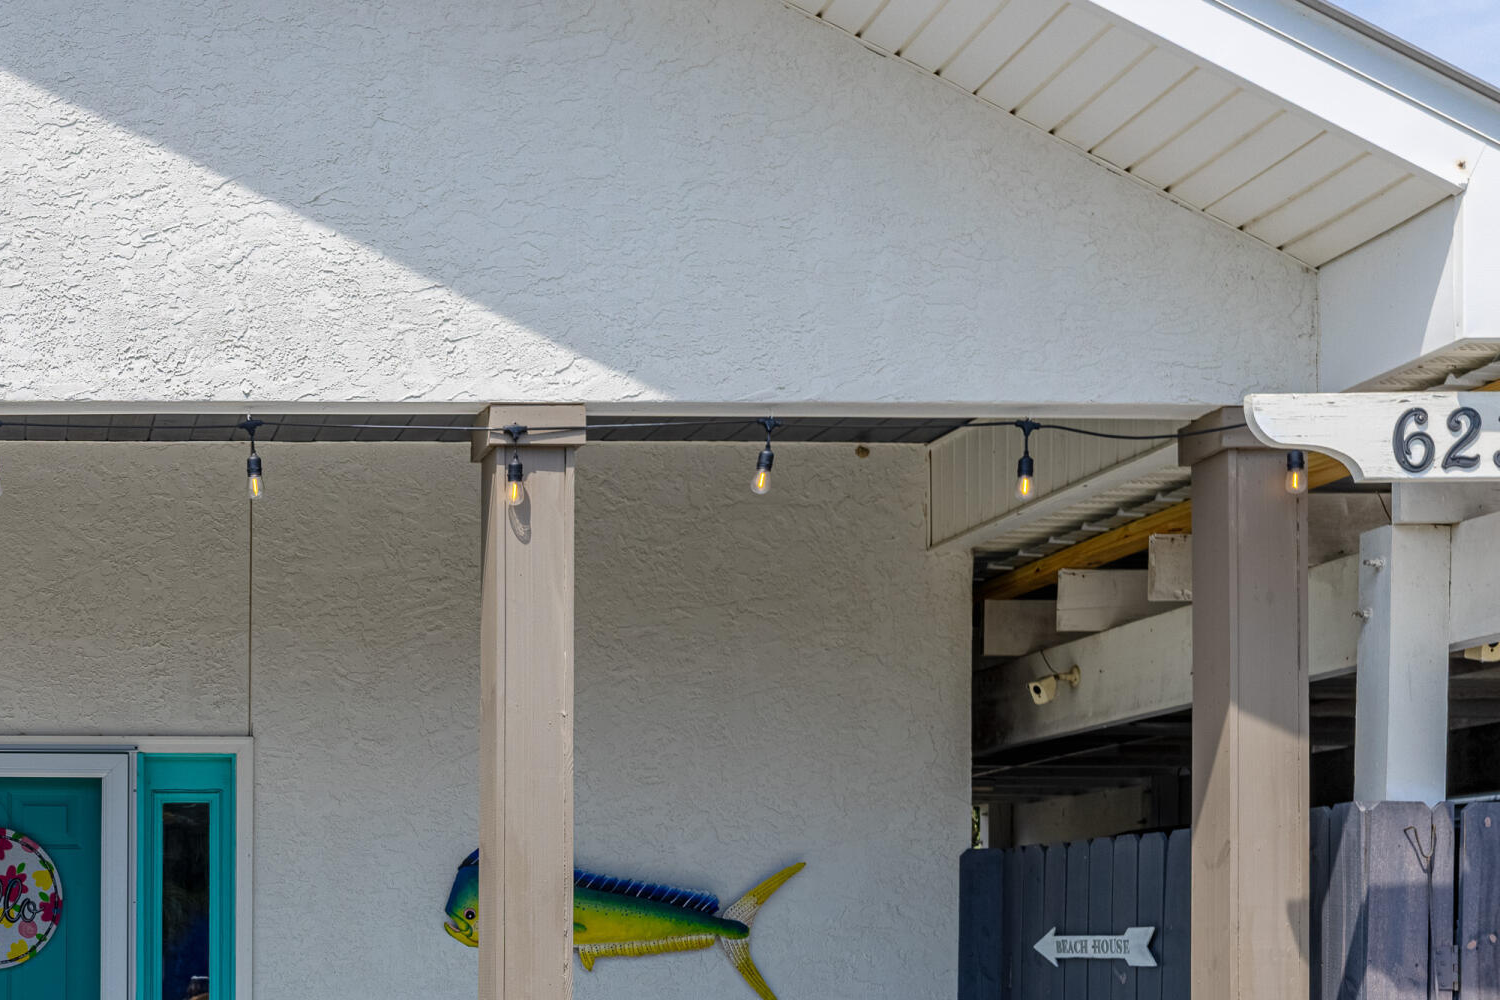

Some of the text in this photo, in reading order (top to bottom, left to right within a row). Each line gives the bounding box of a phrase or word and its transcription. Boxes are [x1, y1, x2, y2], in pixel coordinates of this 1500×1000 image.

[1392, 407, 1500, 473] 62
[1056, 939, 1130, 954] BEACH HOUSE
